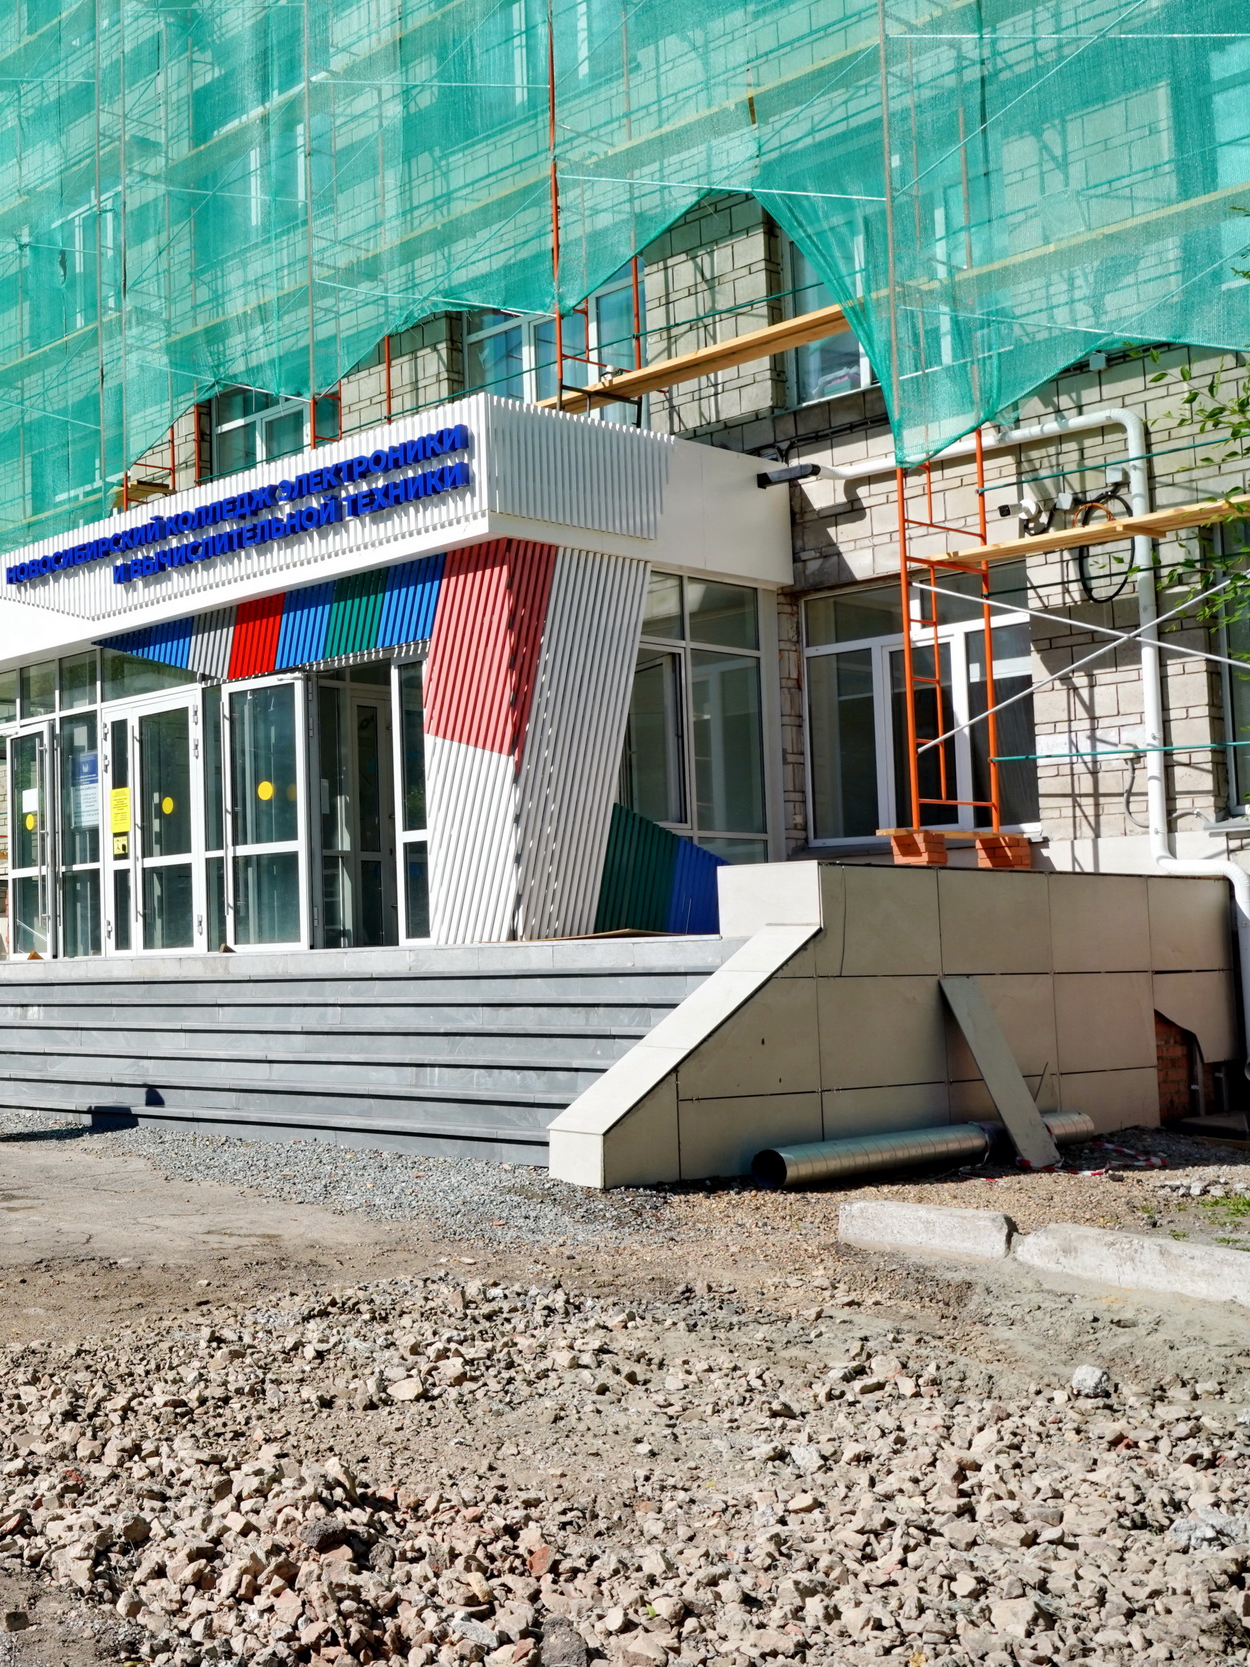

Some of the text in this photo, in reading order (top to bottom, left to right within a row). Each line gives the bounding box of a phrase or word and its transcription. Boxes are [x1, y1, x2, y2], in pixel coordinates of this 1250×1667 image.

[6, 424, 469, 585] НОВОСИБИРСКИЙ КОЛЛЕДЖ ЭЛЕКТРОНИКИ
[113, 462, 469, 585] И ВЫЧИСЛИТЕЛЬНОЙ ТЕХНИКИ
